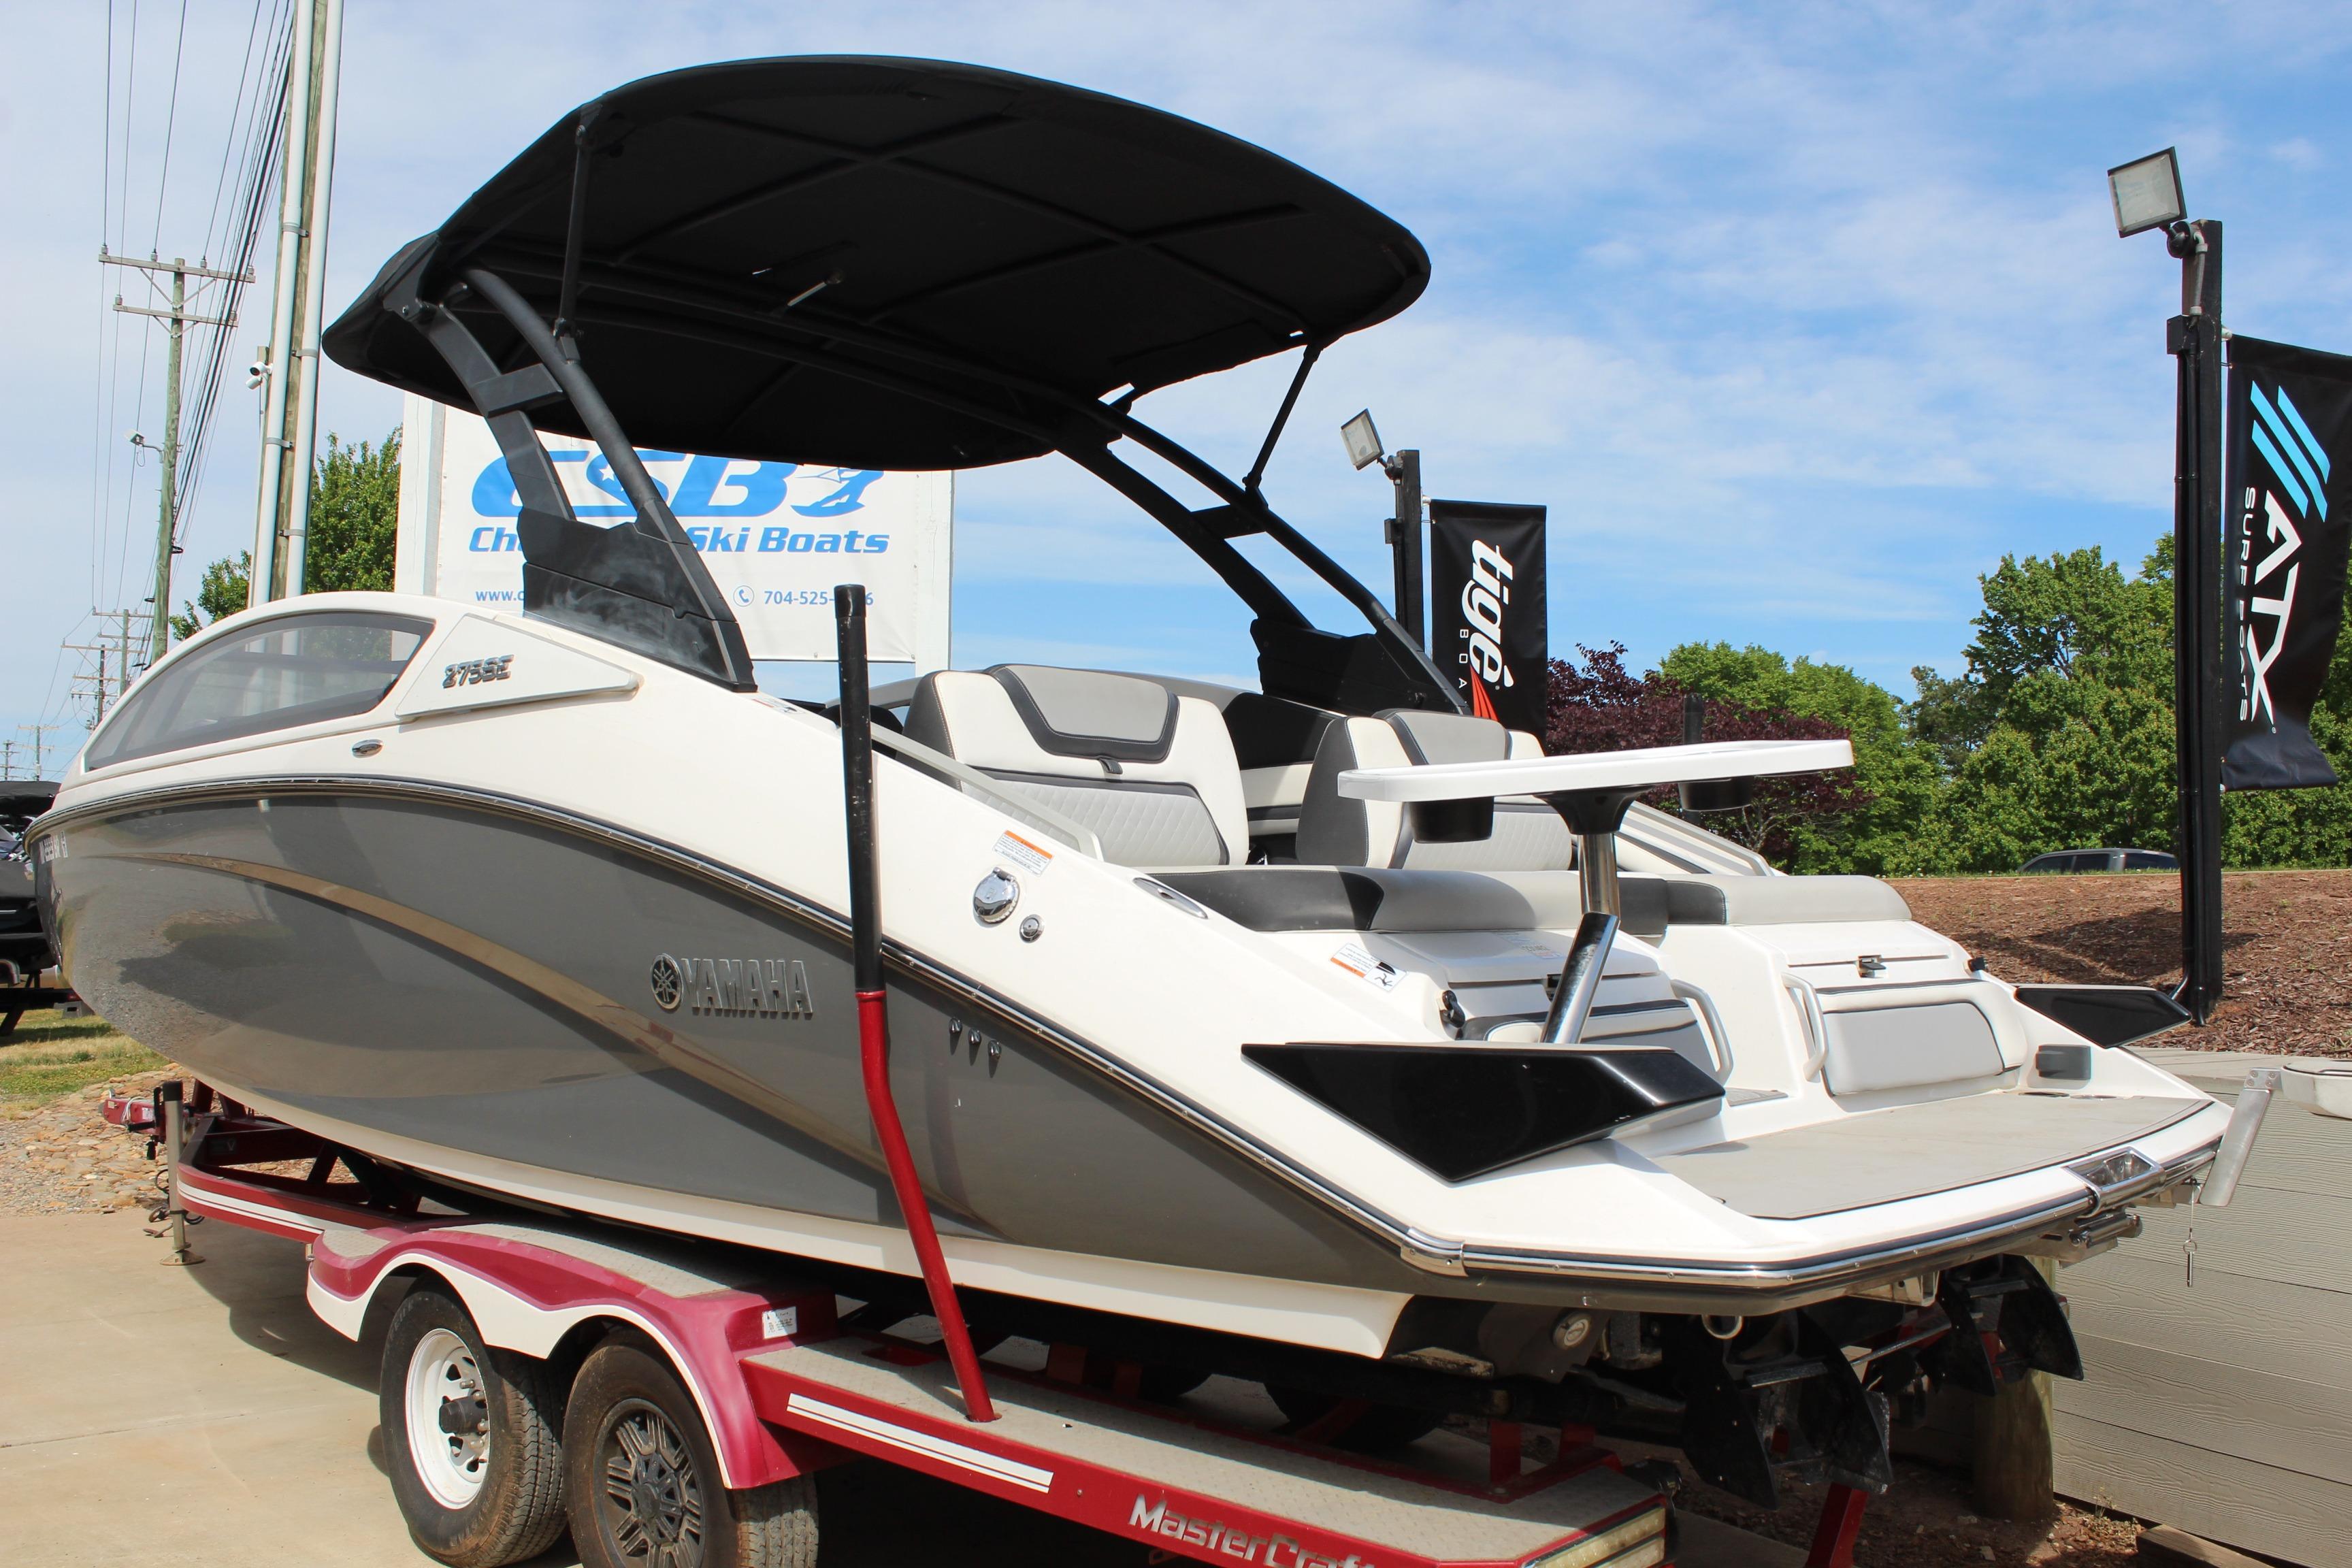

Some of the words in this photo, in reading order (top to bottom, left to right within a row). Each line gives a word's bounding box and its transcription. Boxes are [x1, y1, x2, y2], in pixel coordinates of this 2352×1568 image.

[690, 526, 750, 553] Ski
[757, 528, 889, 553] Boats
[764, 591, 875, 606] 704-525-6
[1462, 540, 1514, 687] tigé
[2247, 490, 2302, 725] ATX
[442, 654, 514, 689] 275SE
[1458, 629, 1469, 689] BOA
[681, 958, 813, 1015] YAMAHA
[1128, 1494, 1375, 1568] MasterCr
